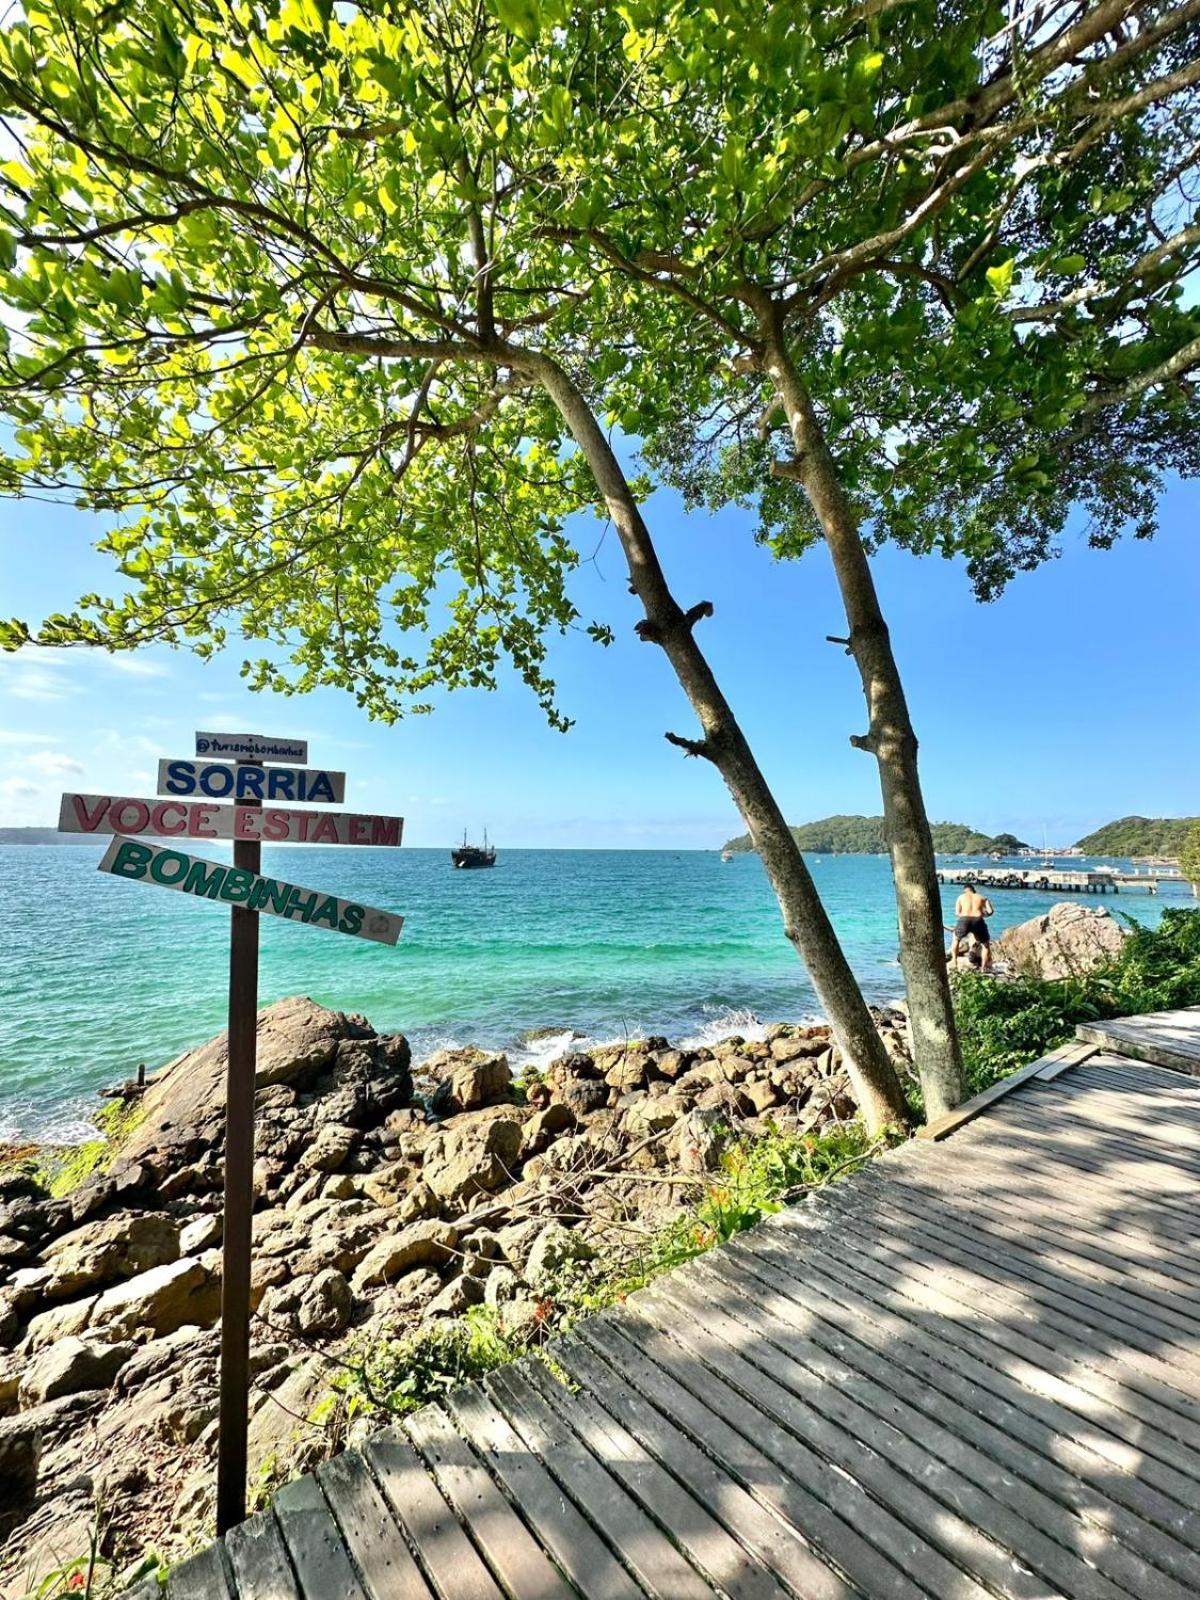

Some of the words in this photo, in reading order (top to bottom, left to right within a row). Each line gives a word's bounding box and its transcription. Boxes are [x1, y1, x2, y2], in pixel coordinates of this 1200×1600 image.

[166, 761, 336, 803] SORRIA
[348, 816, 400, 847] EM
[110, 842, 366, 936] BOMBINHAS
